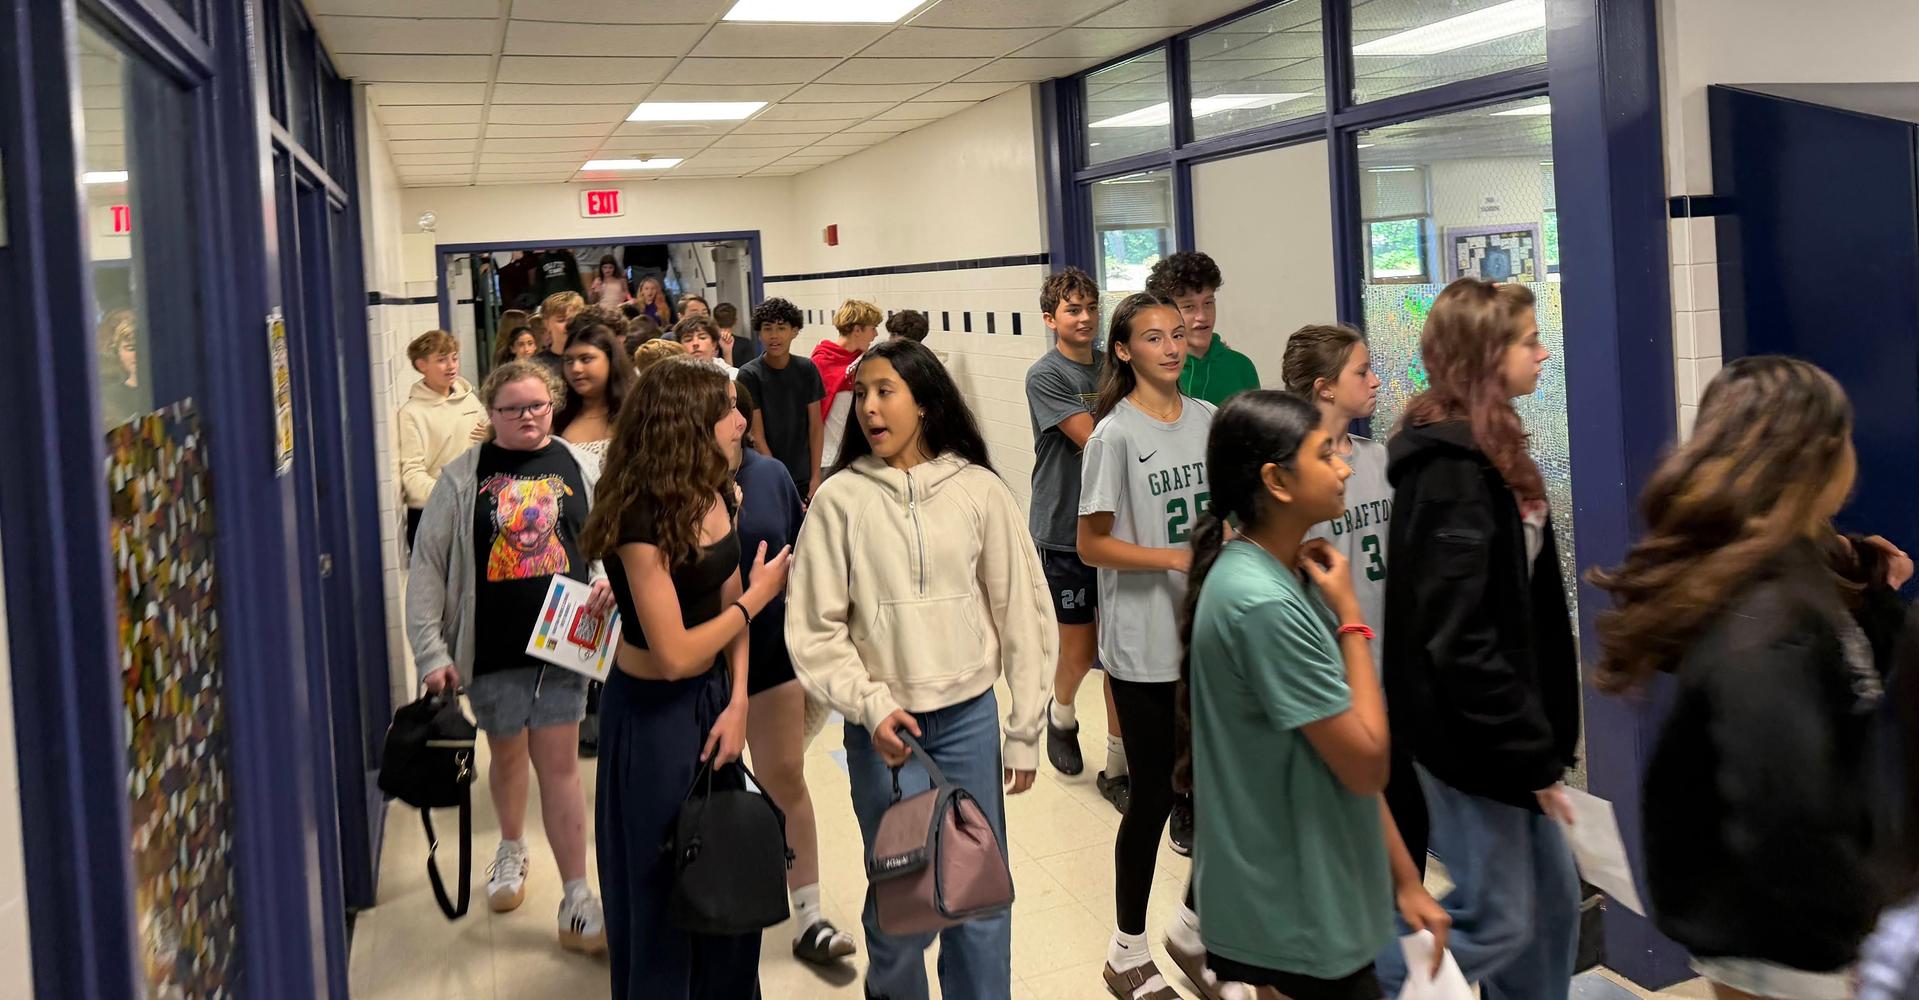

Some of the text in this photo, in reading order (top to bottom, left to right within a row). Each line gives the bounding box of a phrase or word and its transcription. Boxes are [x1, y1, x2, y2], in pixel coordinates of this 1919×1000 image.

[588, 191, 619, 215] EXIT
[1148, 462, 1204, 497] GRAFT
[1330, 498, 1393, 536] GRAFTO
[1061, 588, 1086, 609] 24
